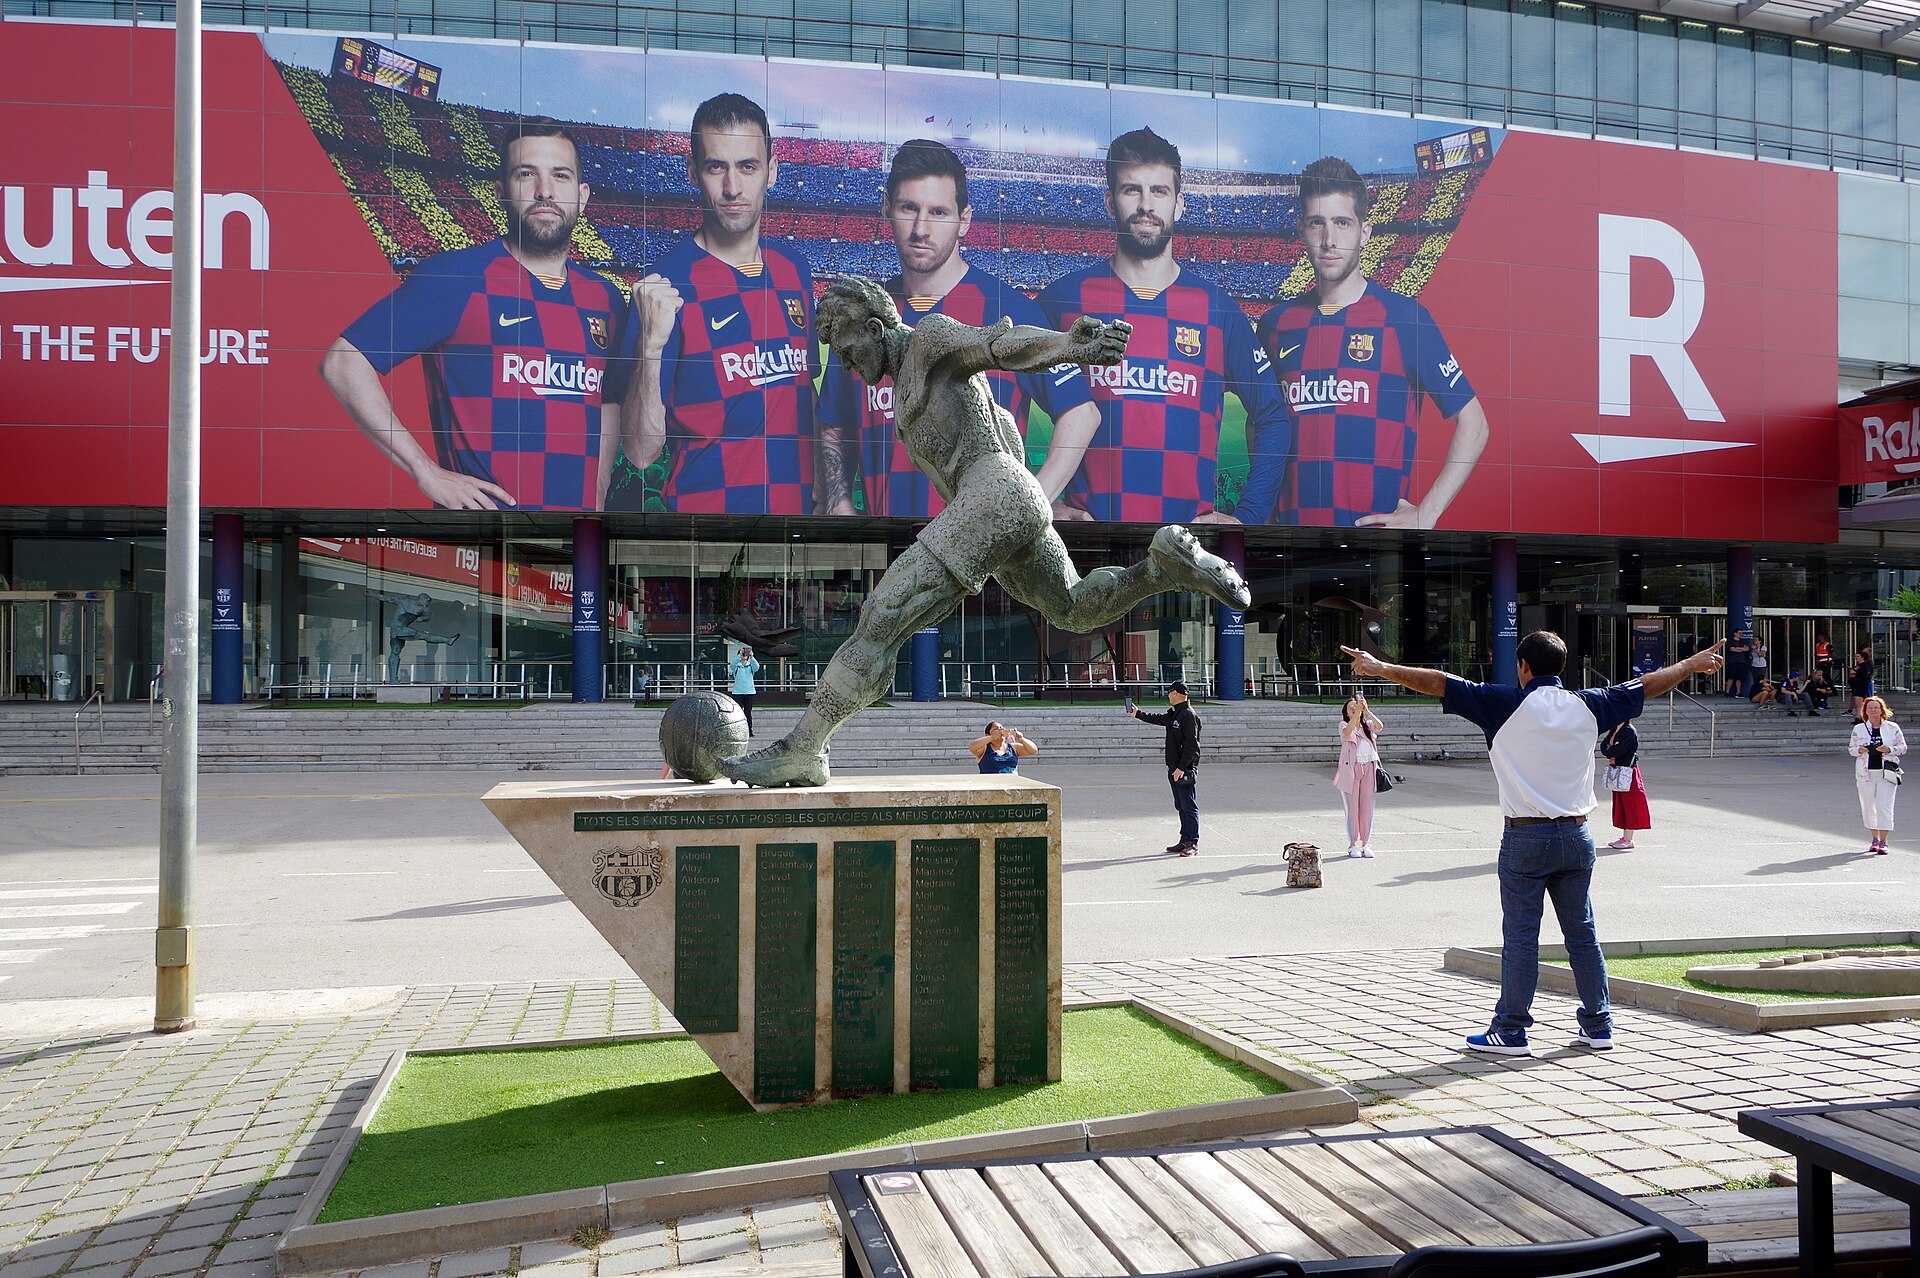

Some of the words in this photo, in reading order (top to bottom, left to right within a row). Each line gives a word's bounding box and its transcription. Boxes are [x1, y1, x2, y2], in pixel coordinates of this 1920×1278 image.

[0, 170, 270, 270] uten
[1599, 213, 1725, 423] R
[13, 324, 95, 361] THE
[108, 327, 270, 364] FUURE
[1089, 360, 1198, 396] Rakuten
[617, 815, 640, 826] ELS
[643, 815, 677, 826] EXITS
[681, 814, 705, 825] HAN
[709, 814, 745, 825] ESTAT
[750, 812, 814, 824] POSSIBLES
[817, 811, 868, 823] GRACIES
[871, 811, 893, 822] ALS
[896, 811, 929, 821] MEUS
[931, 809, 994, 820] COMPANYS
